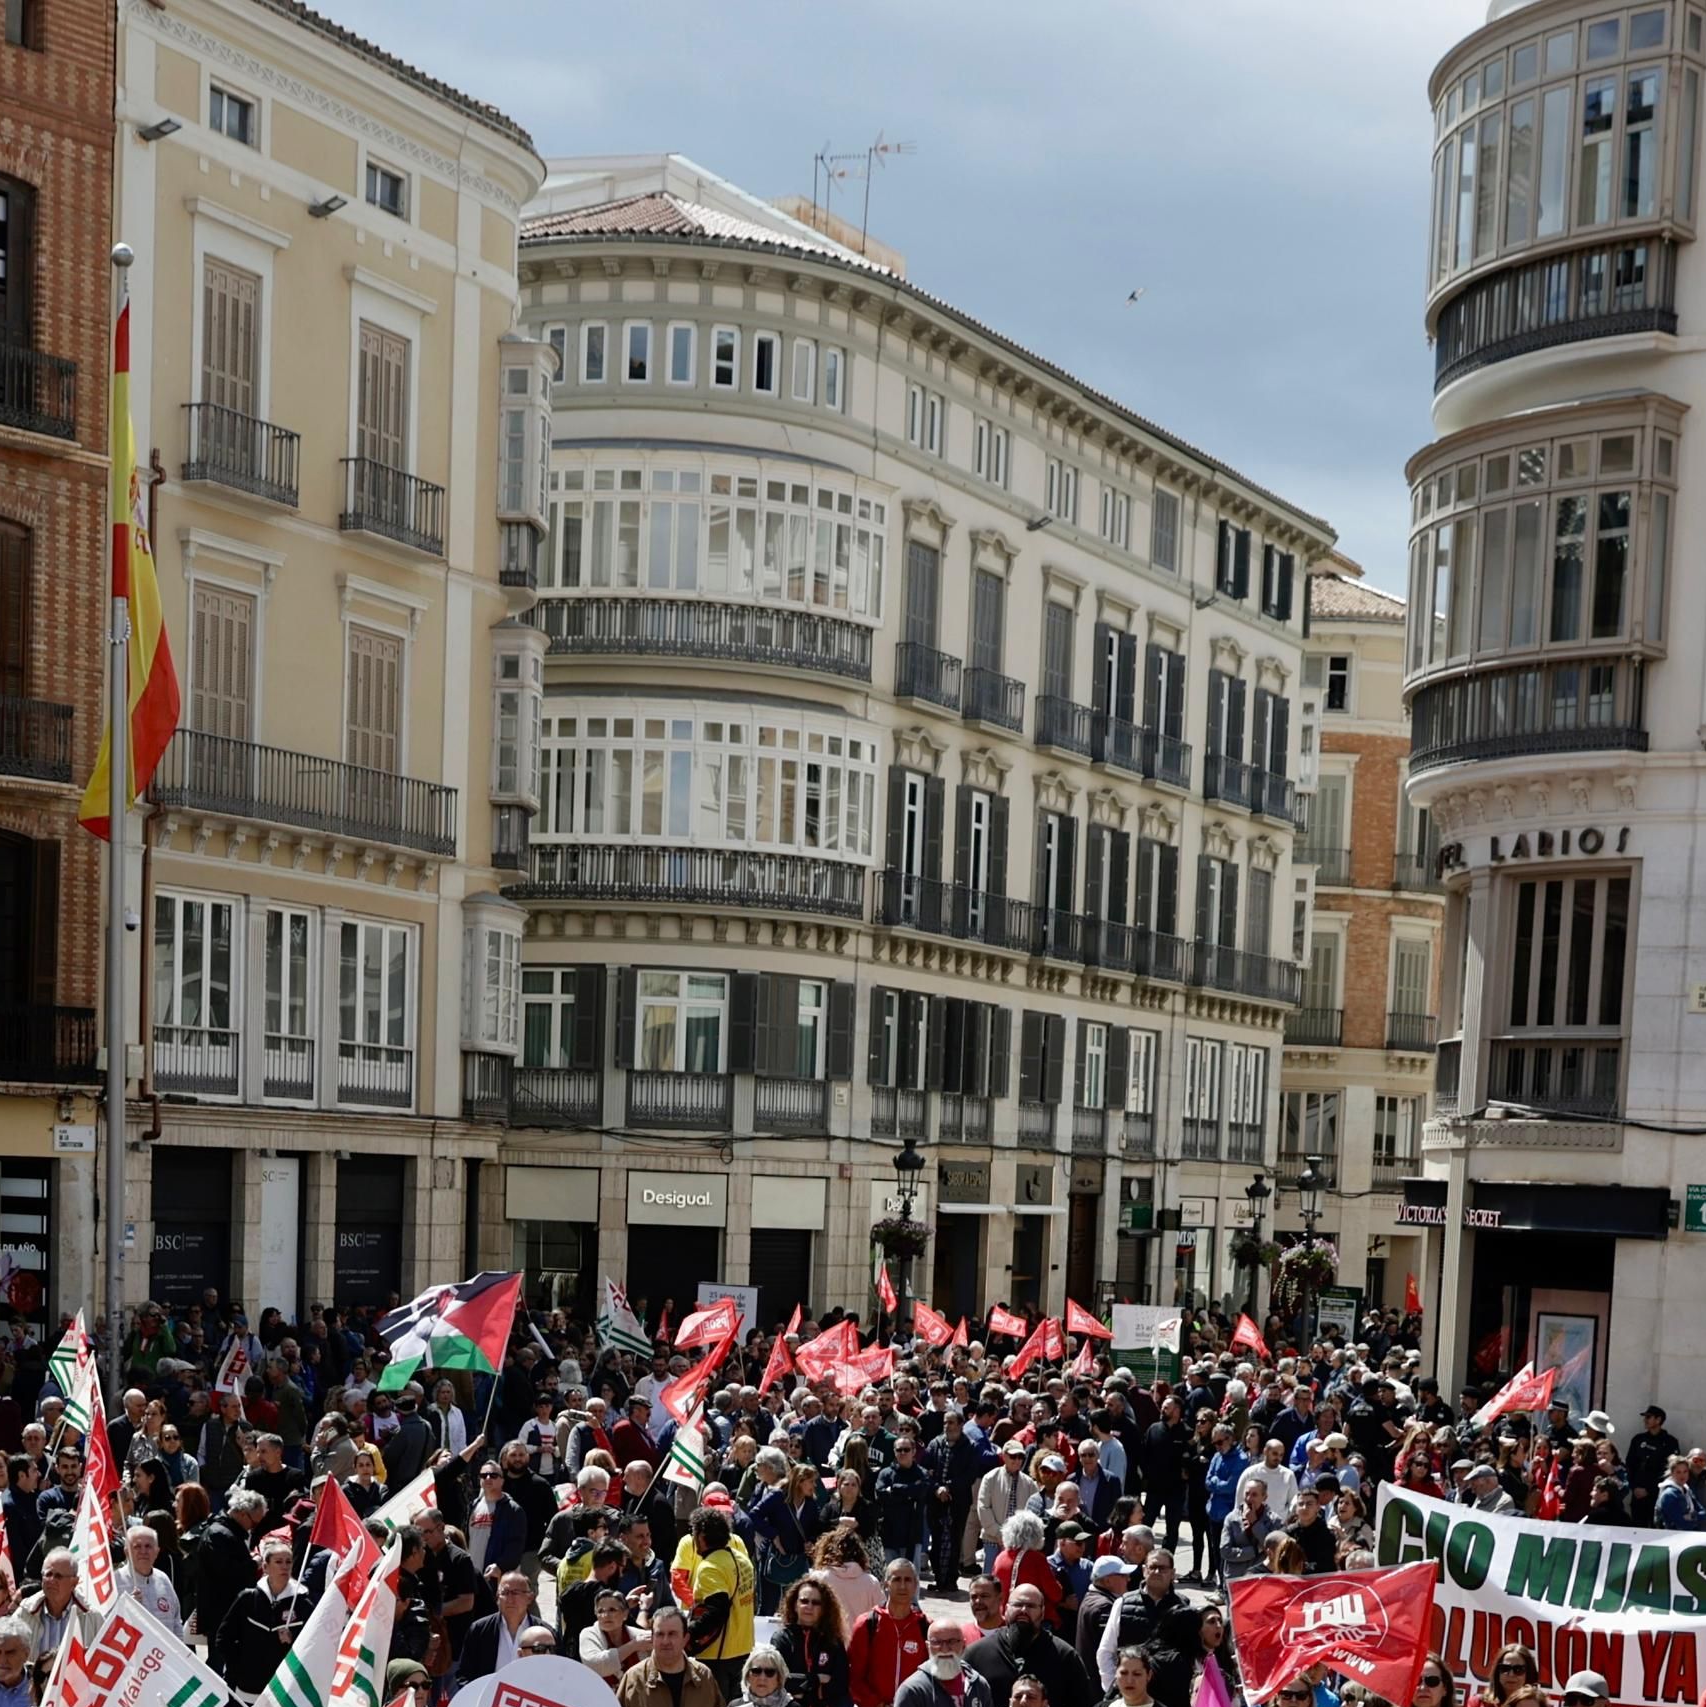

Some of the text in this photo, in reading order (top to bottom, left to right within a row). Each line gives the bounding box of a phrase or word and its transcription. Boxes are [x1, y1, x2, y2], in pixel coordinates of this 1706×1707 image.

[1490, 825, 1630, 861] LARIOS
[262, 1170, 275, 1182] SC
[3, 1243, 15, 1252] DEL
[155, 1235, 182, 1250] BSC
[340, 1233, 363, 1248] BSC
[1431, 1605, 1699, 1704] OLUCIÓN YA
